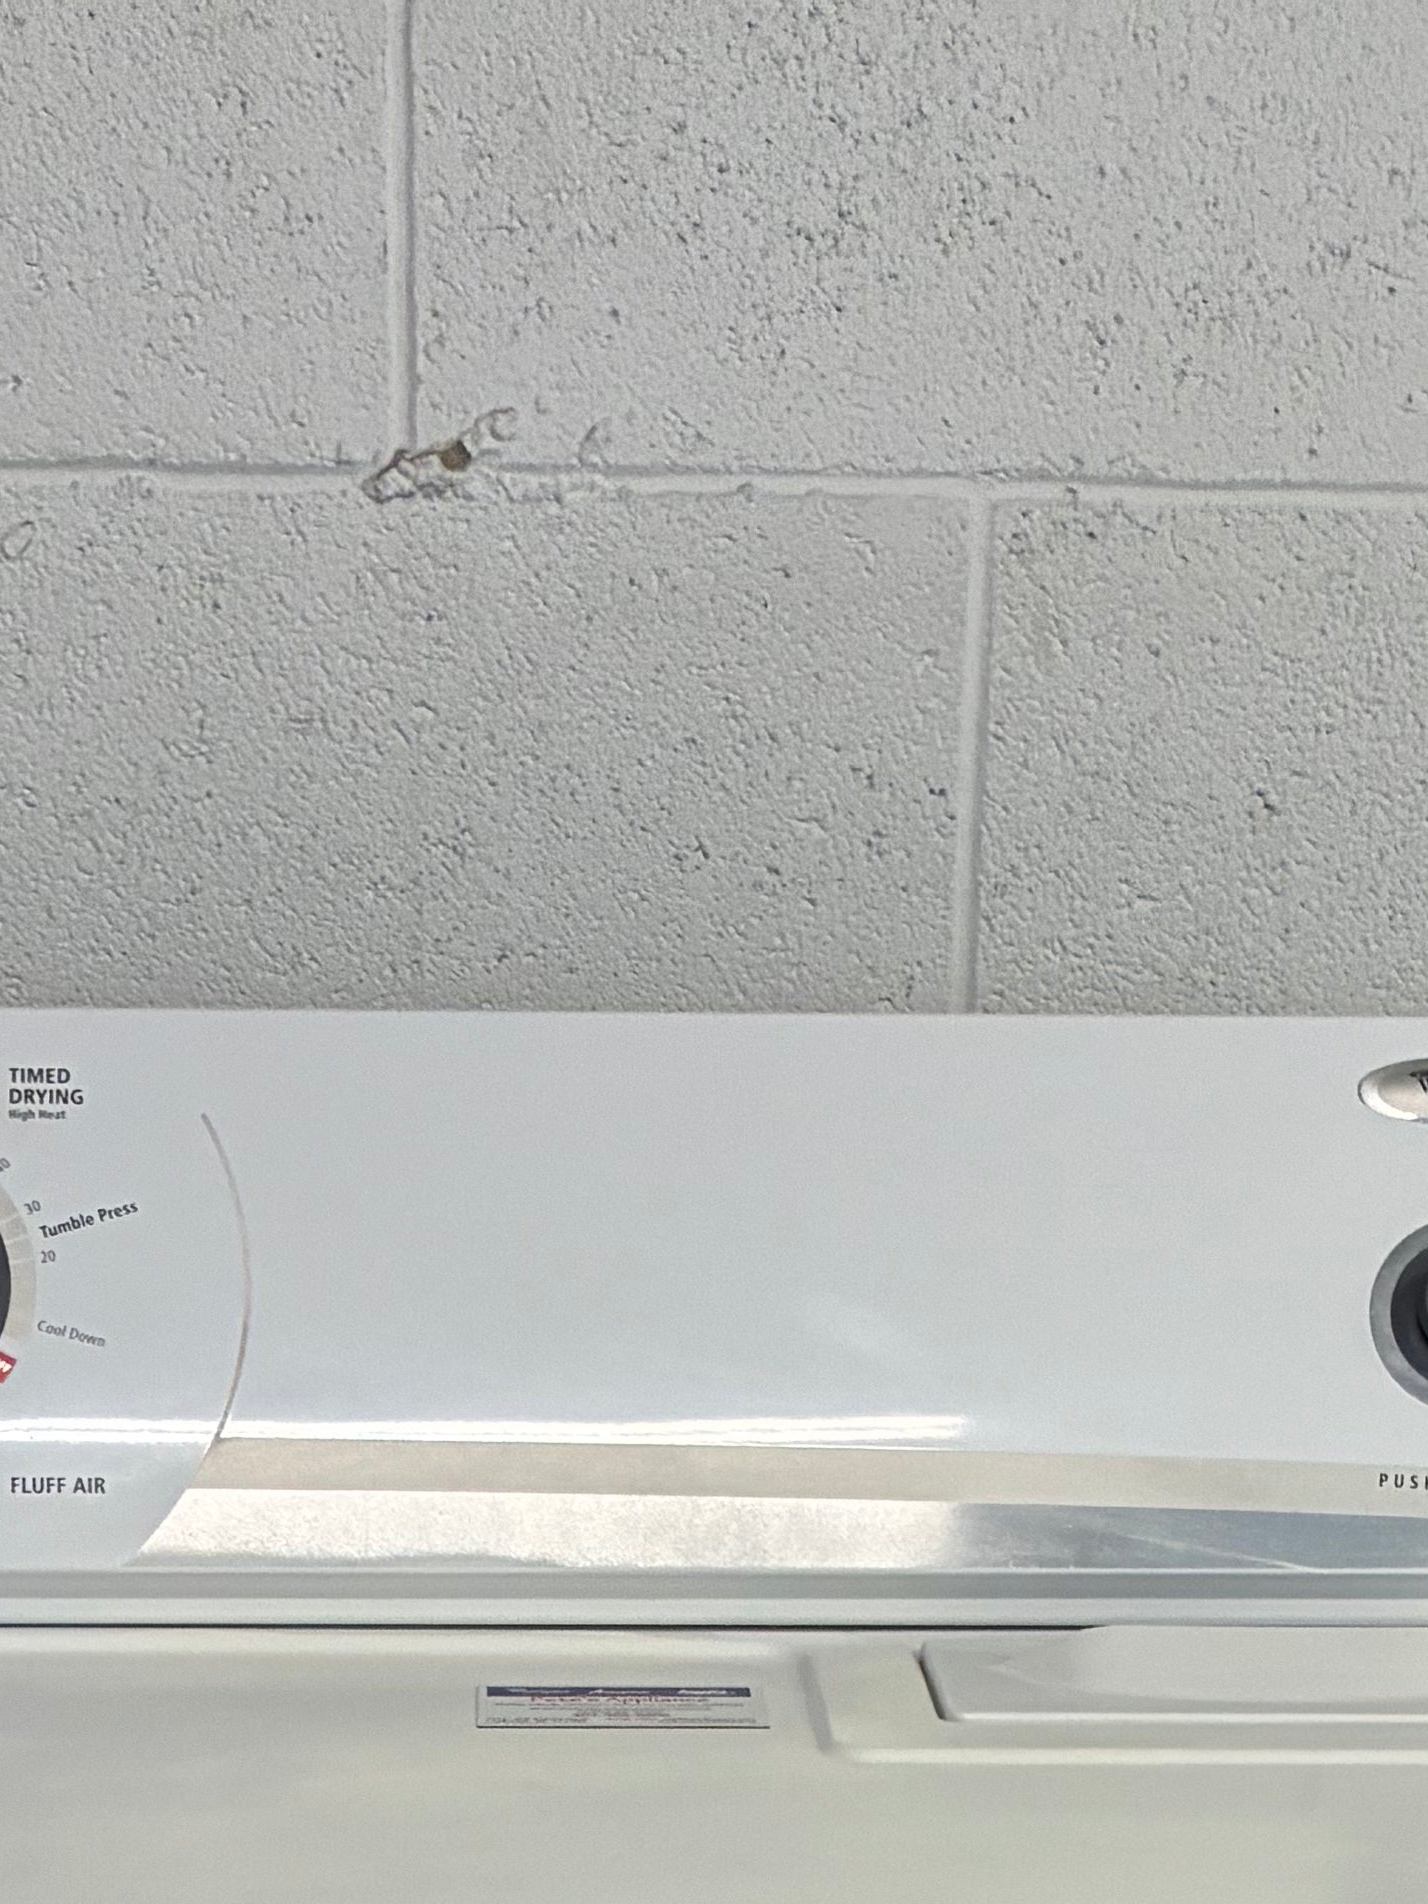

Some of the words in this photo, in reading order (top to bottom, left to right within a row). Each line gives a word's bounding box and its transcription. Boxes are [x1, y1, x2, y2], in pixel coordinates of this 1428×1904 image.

[8, 1068, 70, 1084] TIMED
[8, 1088, 84, 1105] DRYING
[8, 1109, 35, 1121] High
[38, 1109, 66, 1120] Heat
[24, 1200, 42, 1215] 30
[38, 1213, 95, 1239] Tumble
[98, 1202, 140, 1222] Press
[41, 1250, 56, 1264] 20
[37, 1320, 67, 1338] Cool
[69, 1327, 106, 1347] Down
[10, 1476, 67, 1495] FLUFF
[72, 1476, 107, 1495] AIR
